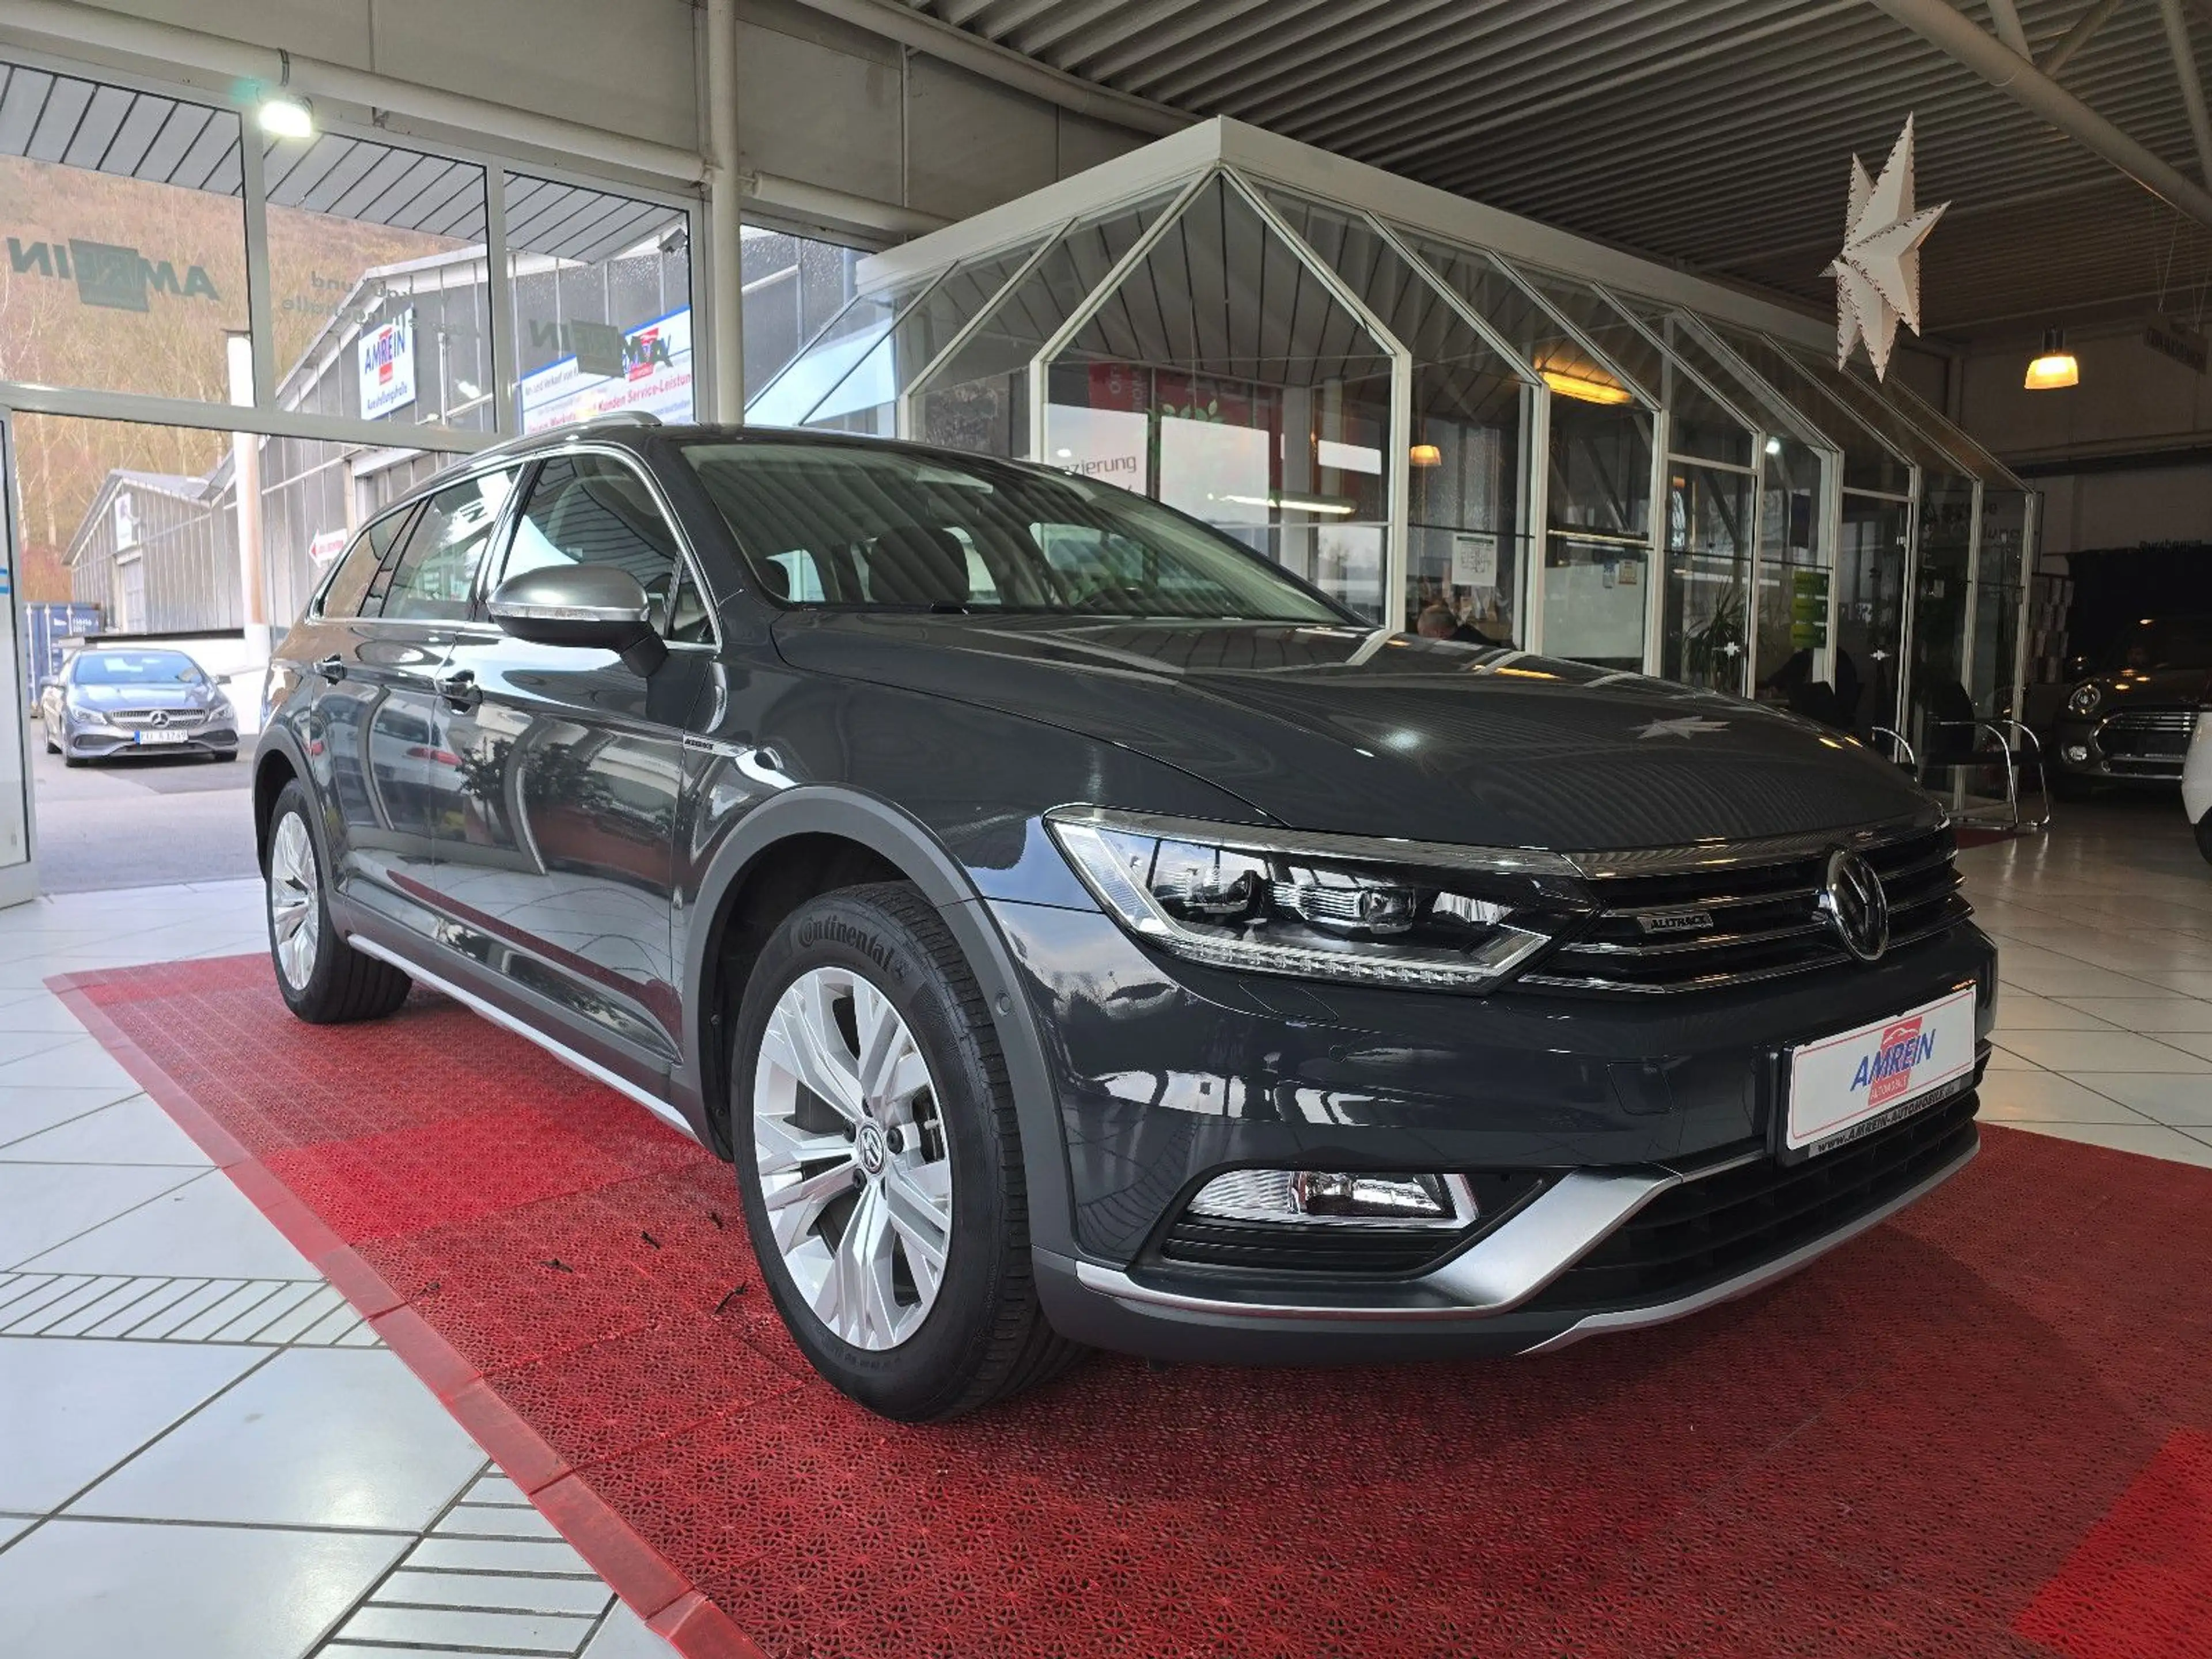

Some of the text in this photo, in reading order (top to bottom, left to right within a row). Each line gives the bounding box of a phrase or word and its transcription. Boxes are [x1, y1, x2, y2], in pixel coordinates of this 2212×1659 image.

[365, 329, 406, 374] AMREIN
[1650, 915, 1706, 930] ALLTRACK
[1850, 1028, 1936, 1092] AMREIN
